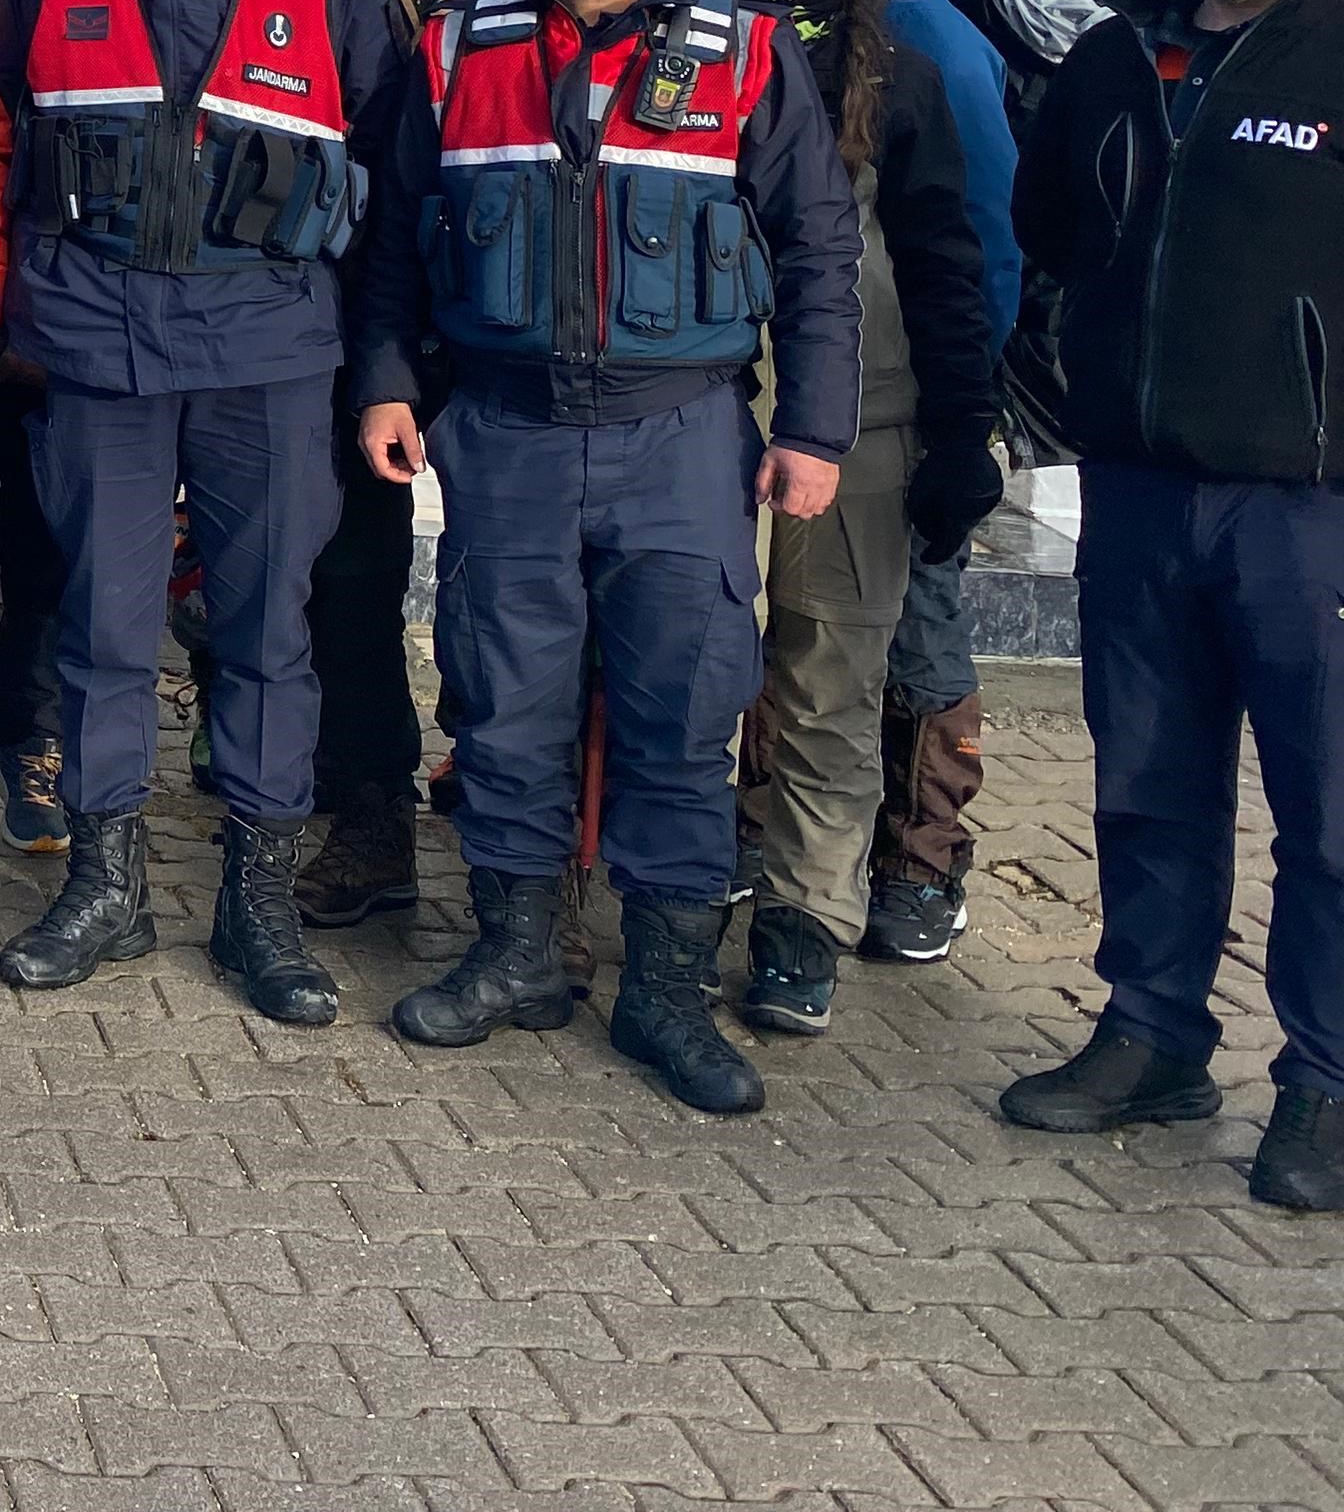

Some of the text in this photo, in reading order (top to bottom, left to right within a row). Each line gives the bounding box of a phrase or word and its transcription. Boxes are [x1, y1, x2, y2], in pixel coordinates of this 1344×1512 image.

[248, 67, 307, 93] JANDARMA
[680, 113, 719, 128] ARMA
[1230, 117, 1319, 151] AFAD
